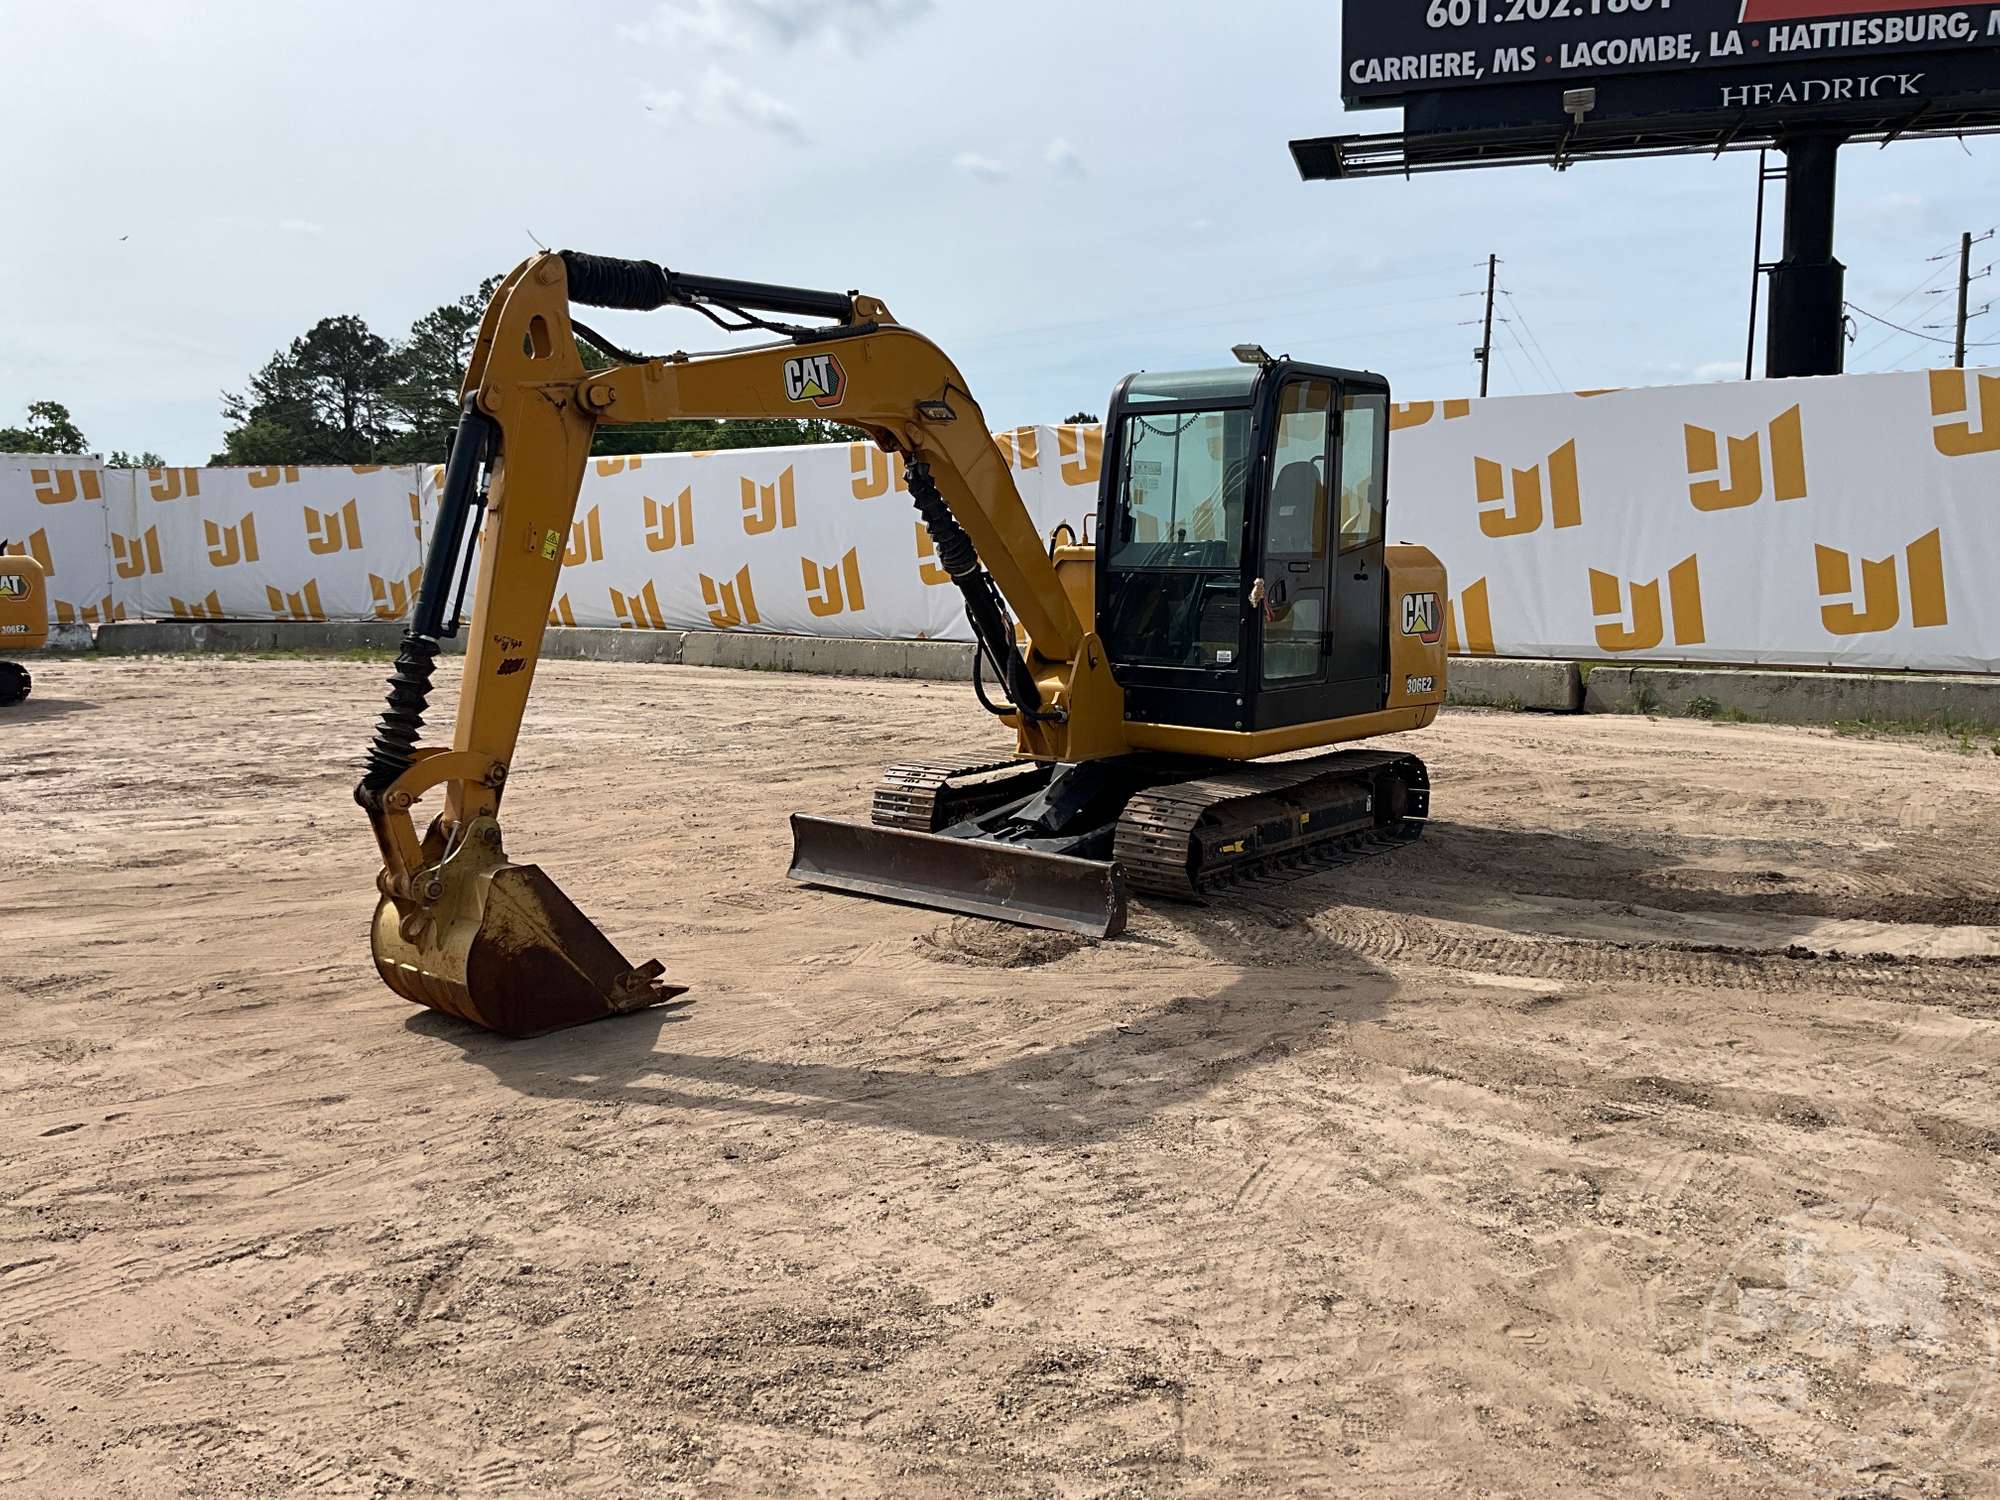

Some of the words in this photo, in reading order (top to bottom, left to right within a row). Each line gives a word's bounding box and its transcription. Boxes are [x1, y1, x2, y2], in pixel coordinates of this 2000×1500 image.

[1426, 0, 1670, 28] 601.202.
[1350, 50, 1484, 84] CARRIERE,
[1493, 46, 1536, 74] MS
[1560, 34, 1700, 69] LACOMBE,
[1710, 30, 1744, 57] LA
[1768, 12, 1978, 53] HATTIESBURG,
[1720, 72, 1925, 107] HEADRICK
[785, 356, 829, 400] CAT
[0, 576, 20, 595] AT
[1402, 594, 1434, 634] CAT
[1407, 677, 1432, 693] 306E2
